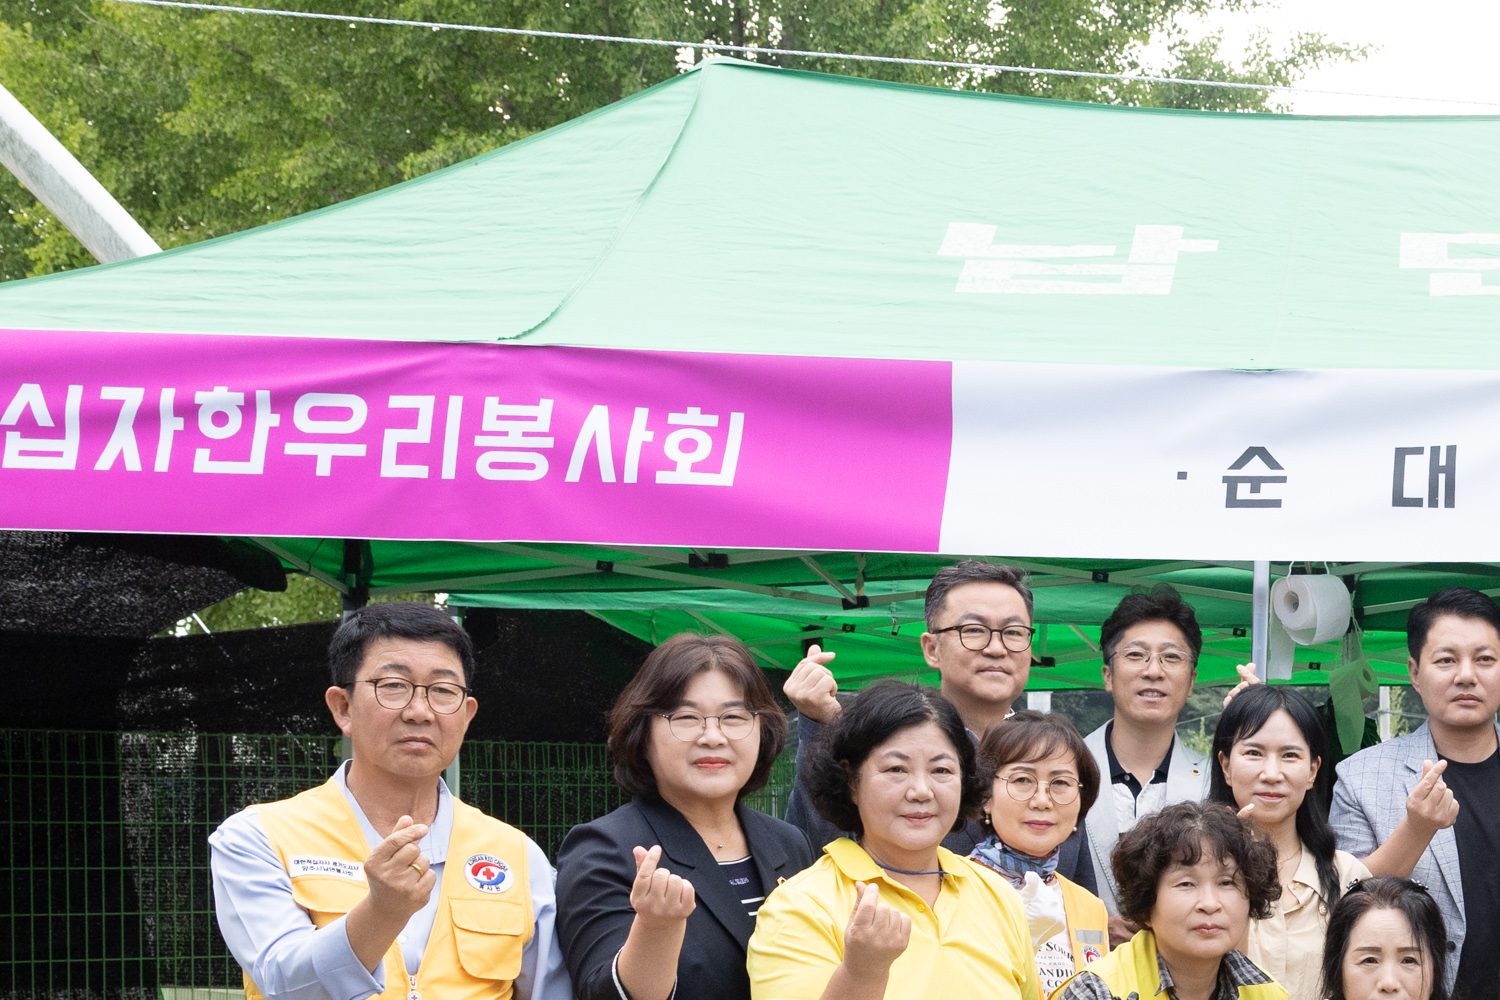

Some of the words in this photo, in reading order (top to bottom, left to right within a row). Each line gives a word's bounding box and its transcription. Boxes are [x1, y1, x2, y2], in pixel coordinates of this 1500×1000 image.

[938, 222, 1219, 296] 남
[0, 382, 746, 487] 십자한우리봉사회
[1222, 445, 1288, 510] 순
[1391, 444, 1458, 510] 대
